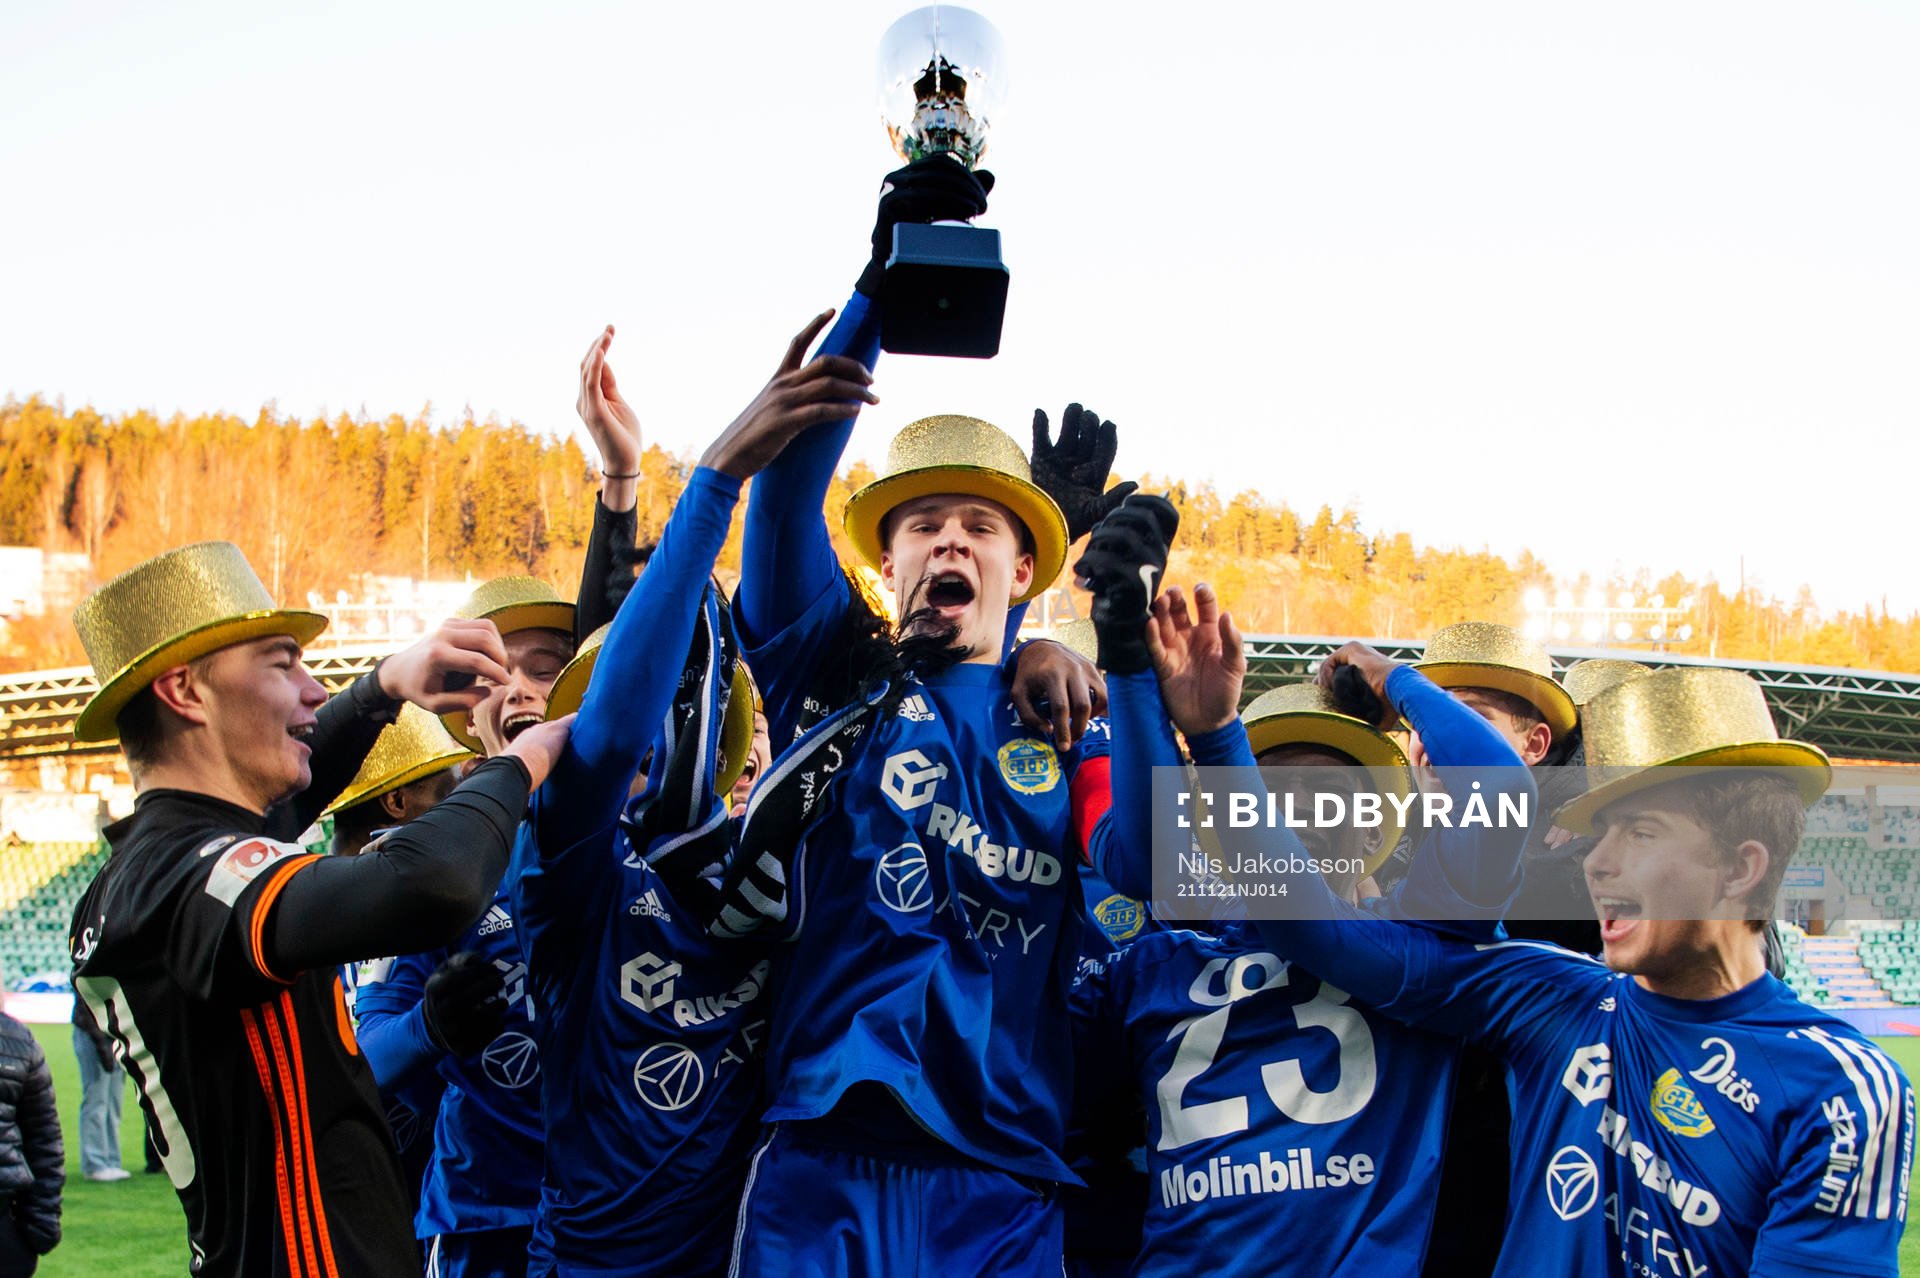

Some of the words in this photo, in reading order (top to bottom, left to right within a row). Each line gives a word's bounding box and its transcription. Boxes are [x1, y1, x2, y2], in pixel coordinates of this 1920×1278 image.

[898, 708, 935, 721] didas
[926, 802, 1061, 886] RKBUD
[477, 916, 513, 936] adida
[629, 902, 671, 923] adidas
[1157, 952, 1377, 1152] 23
[1688, 1037, 1760, 1113] Diös
[1160, 1147, 1375, 1209] Molinbil.se
[1815, 1096, 1859, 1214] stadium
